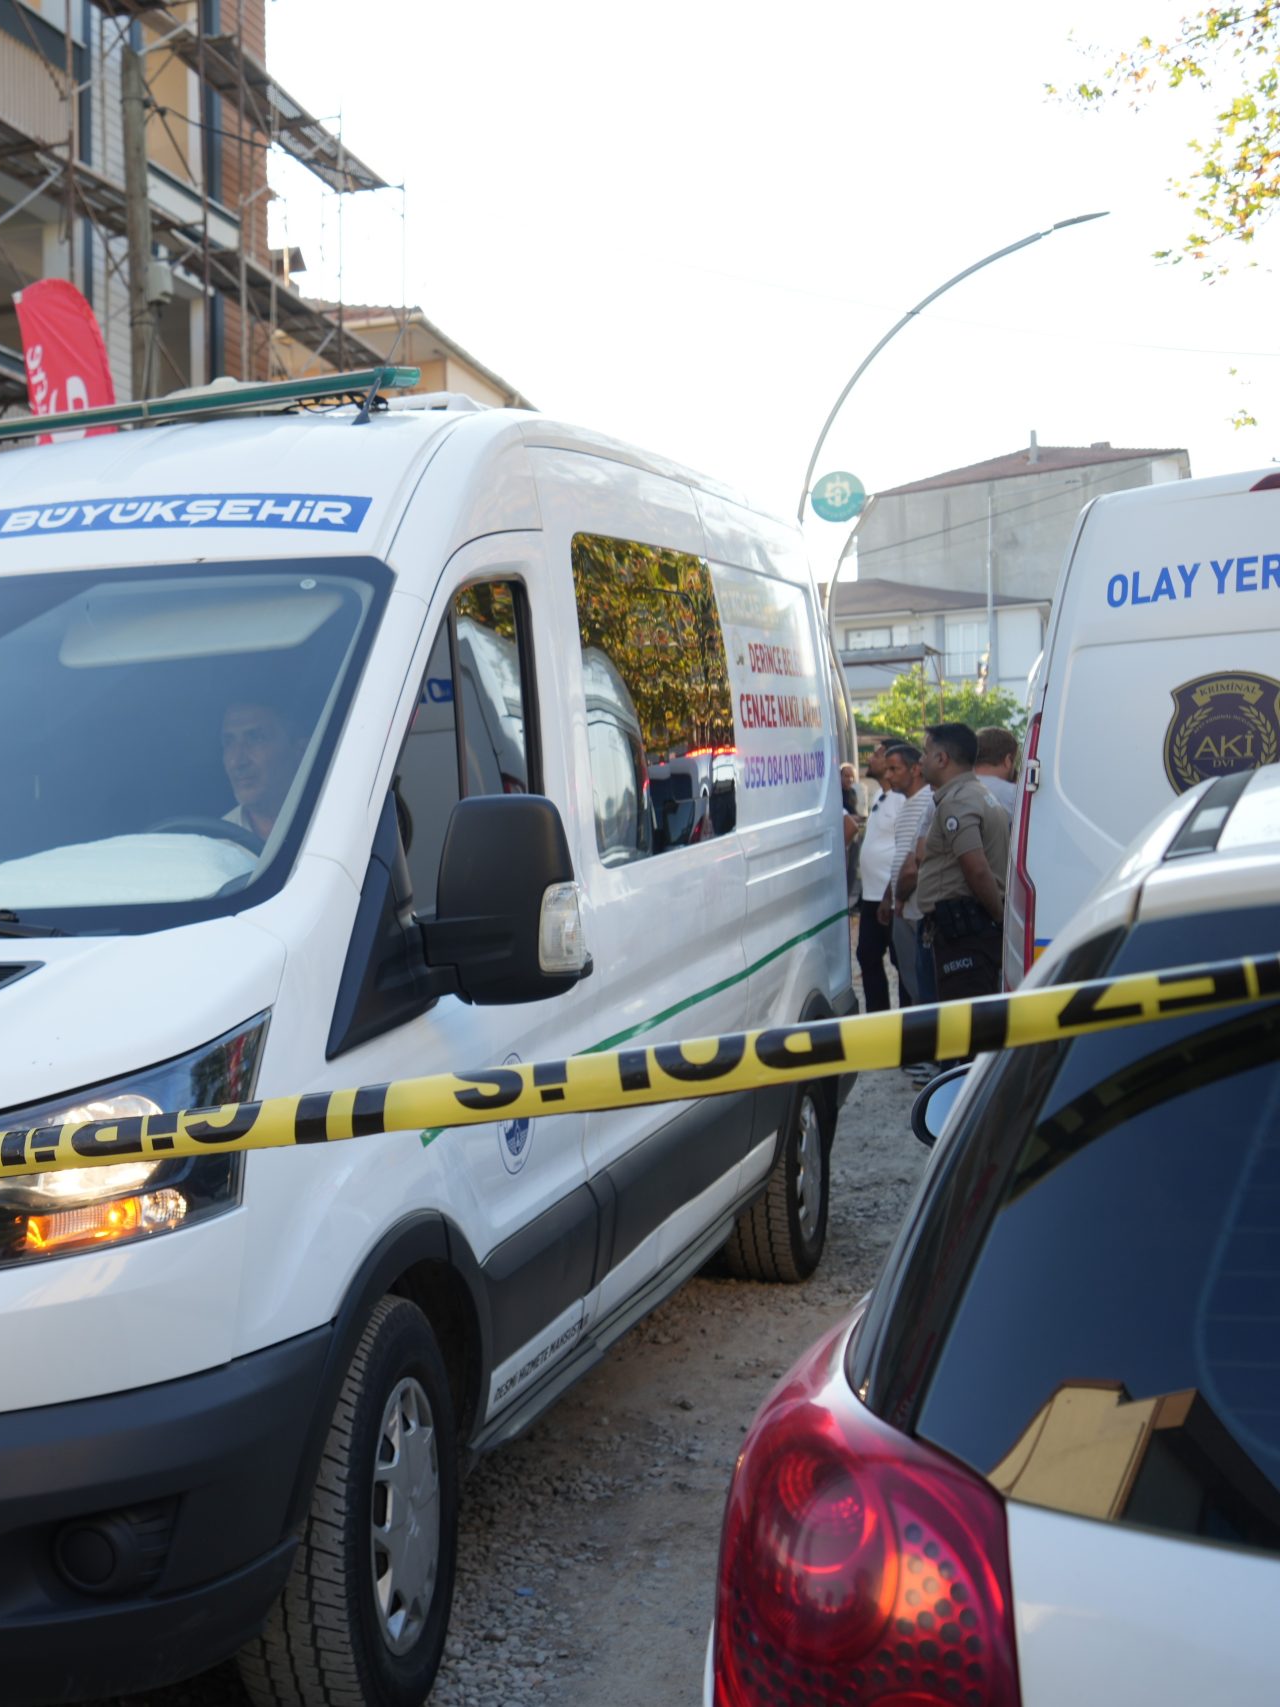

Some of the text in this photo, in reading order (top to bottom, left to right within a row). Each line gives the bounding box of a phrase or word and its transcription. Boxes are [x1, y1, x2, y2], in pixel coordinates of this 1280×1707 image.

[0, 498, 352, 534] BÜYÜKŞEHİR
[1106, 552, 1280, 608] OLAY YER
[748, 642, 783, 675] DERİNCE
[739, 693, 778, 730] CENAZE
[779, 694, 803, 729] NAKİL
[1194, 730, 1255, 759] AKİ
[744, 755, 767, 790] 0552
